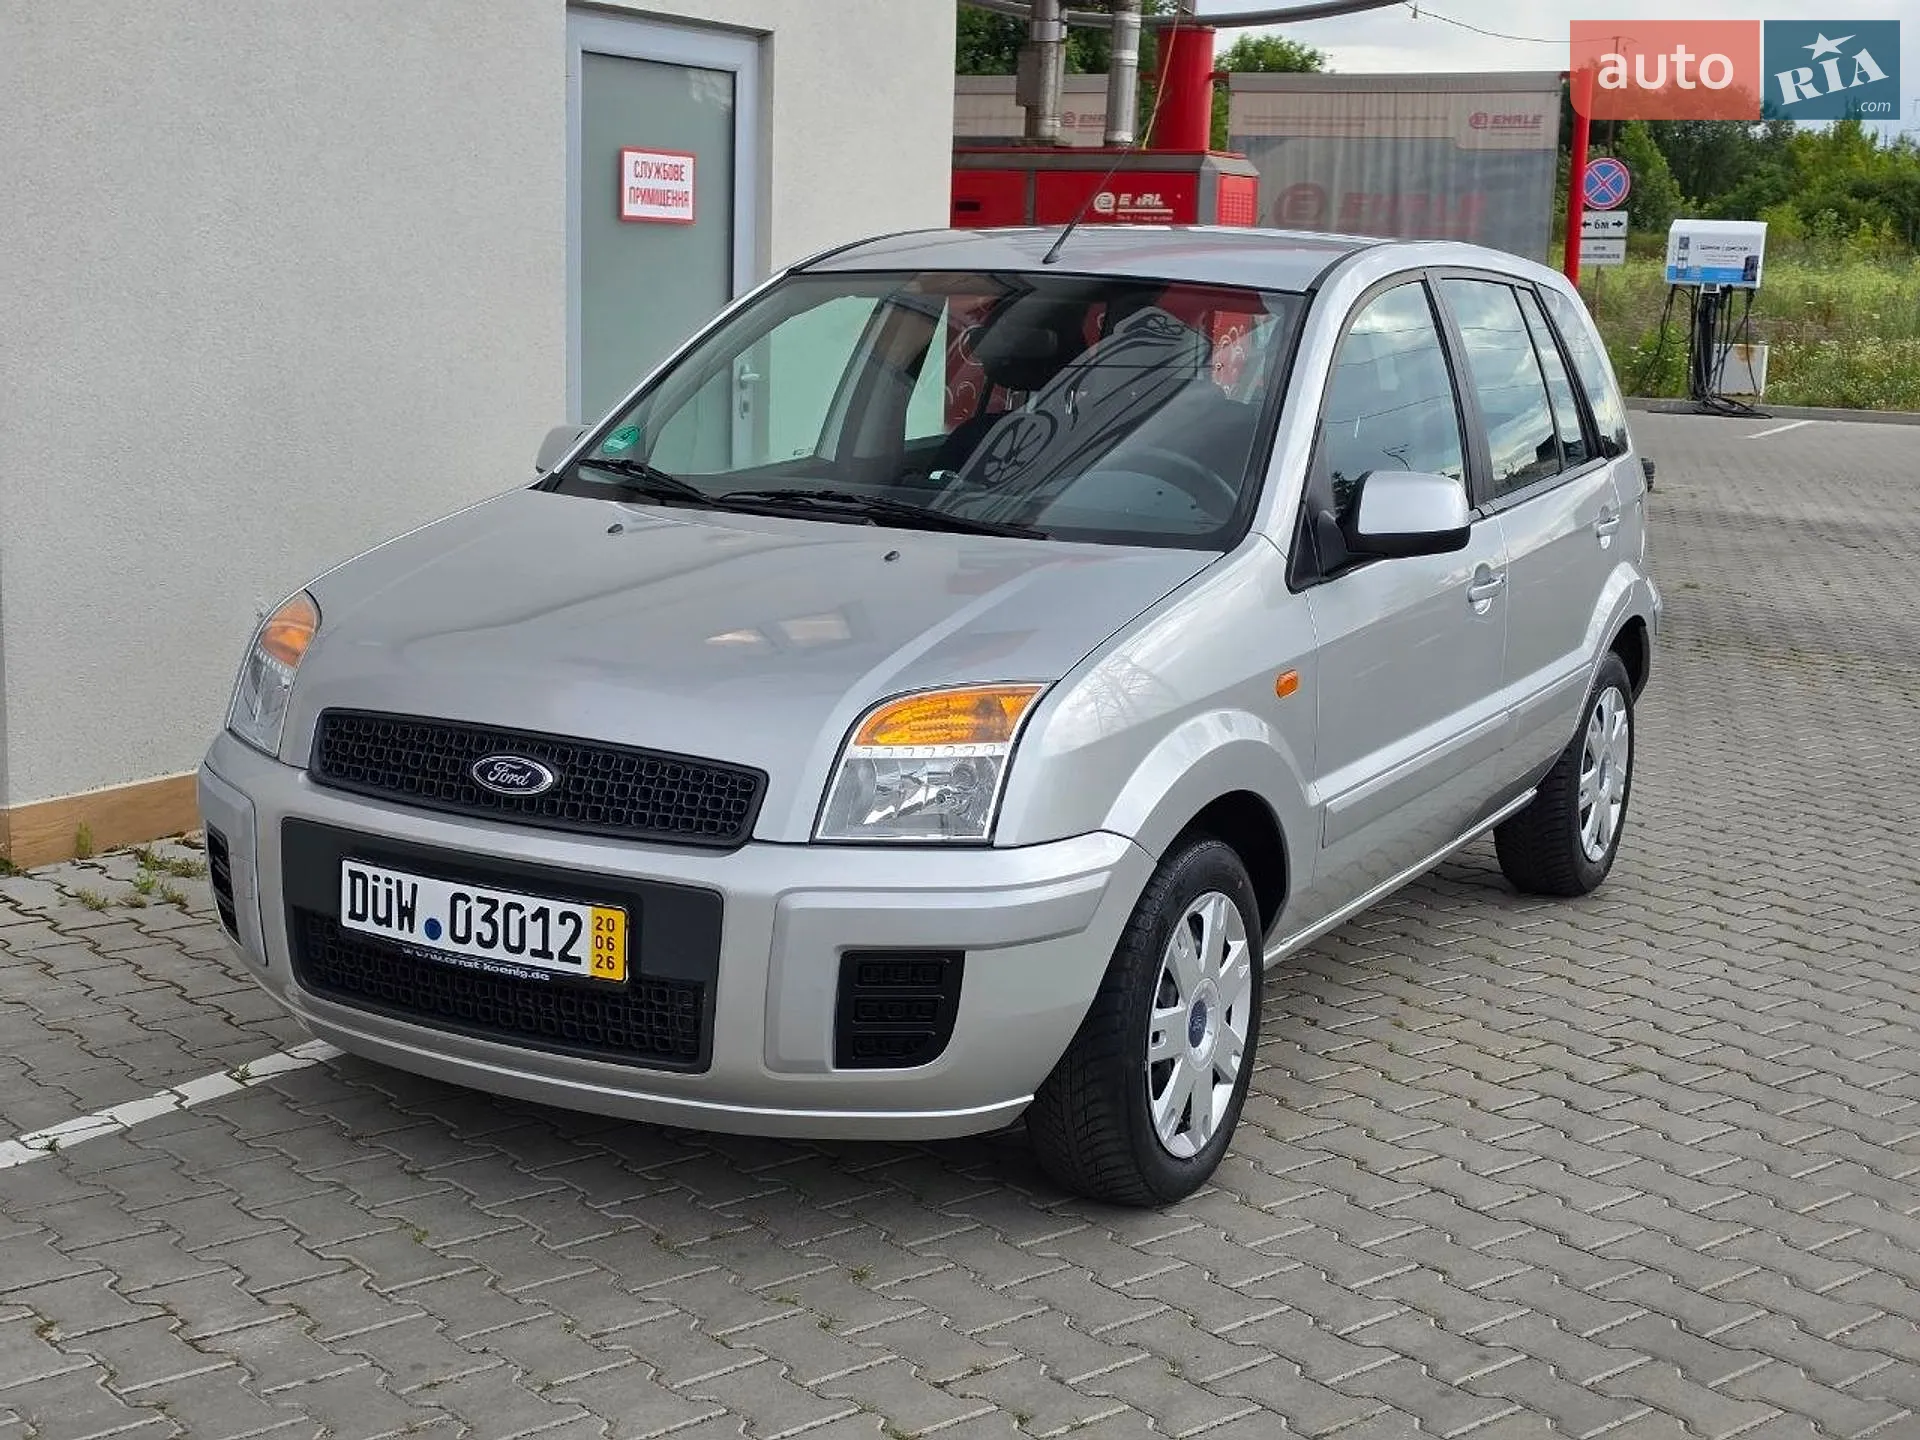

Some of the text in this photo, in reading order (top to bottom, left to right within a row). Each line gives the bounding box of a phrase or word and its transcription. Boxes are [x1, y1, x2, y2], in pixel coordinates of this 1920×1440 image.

[633, 160, 686, 182] СЛУЖБОВЕ
[487, 761, 532, 786] Ford
[449, 892, 583, 965] 03012
[595, 916, 615, 933] 20
[595, 934, 615, 952] 06
[595, 953, 615, 971] 26
